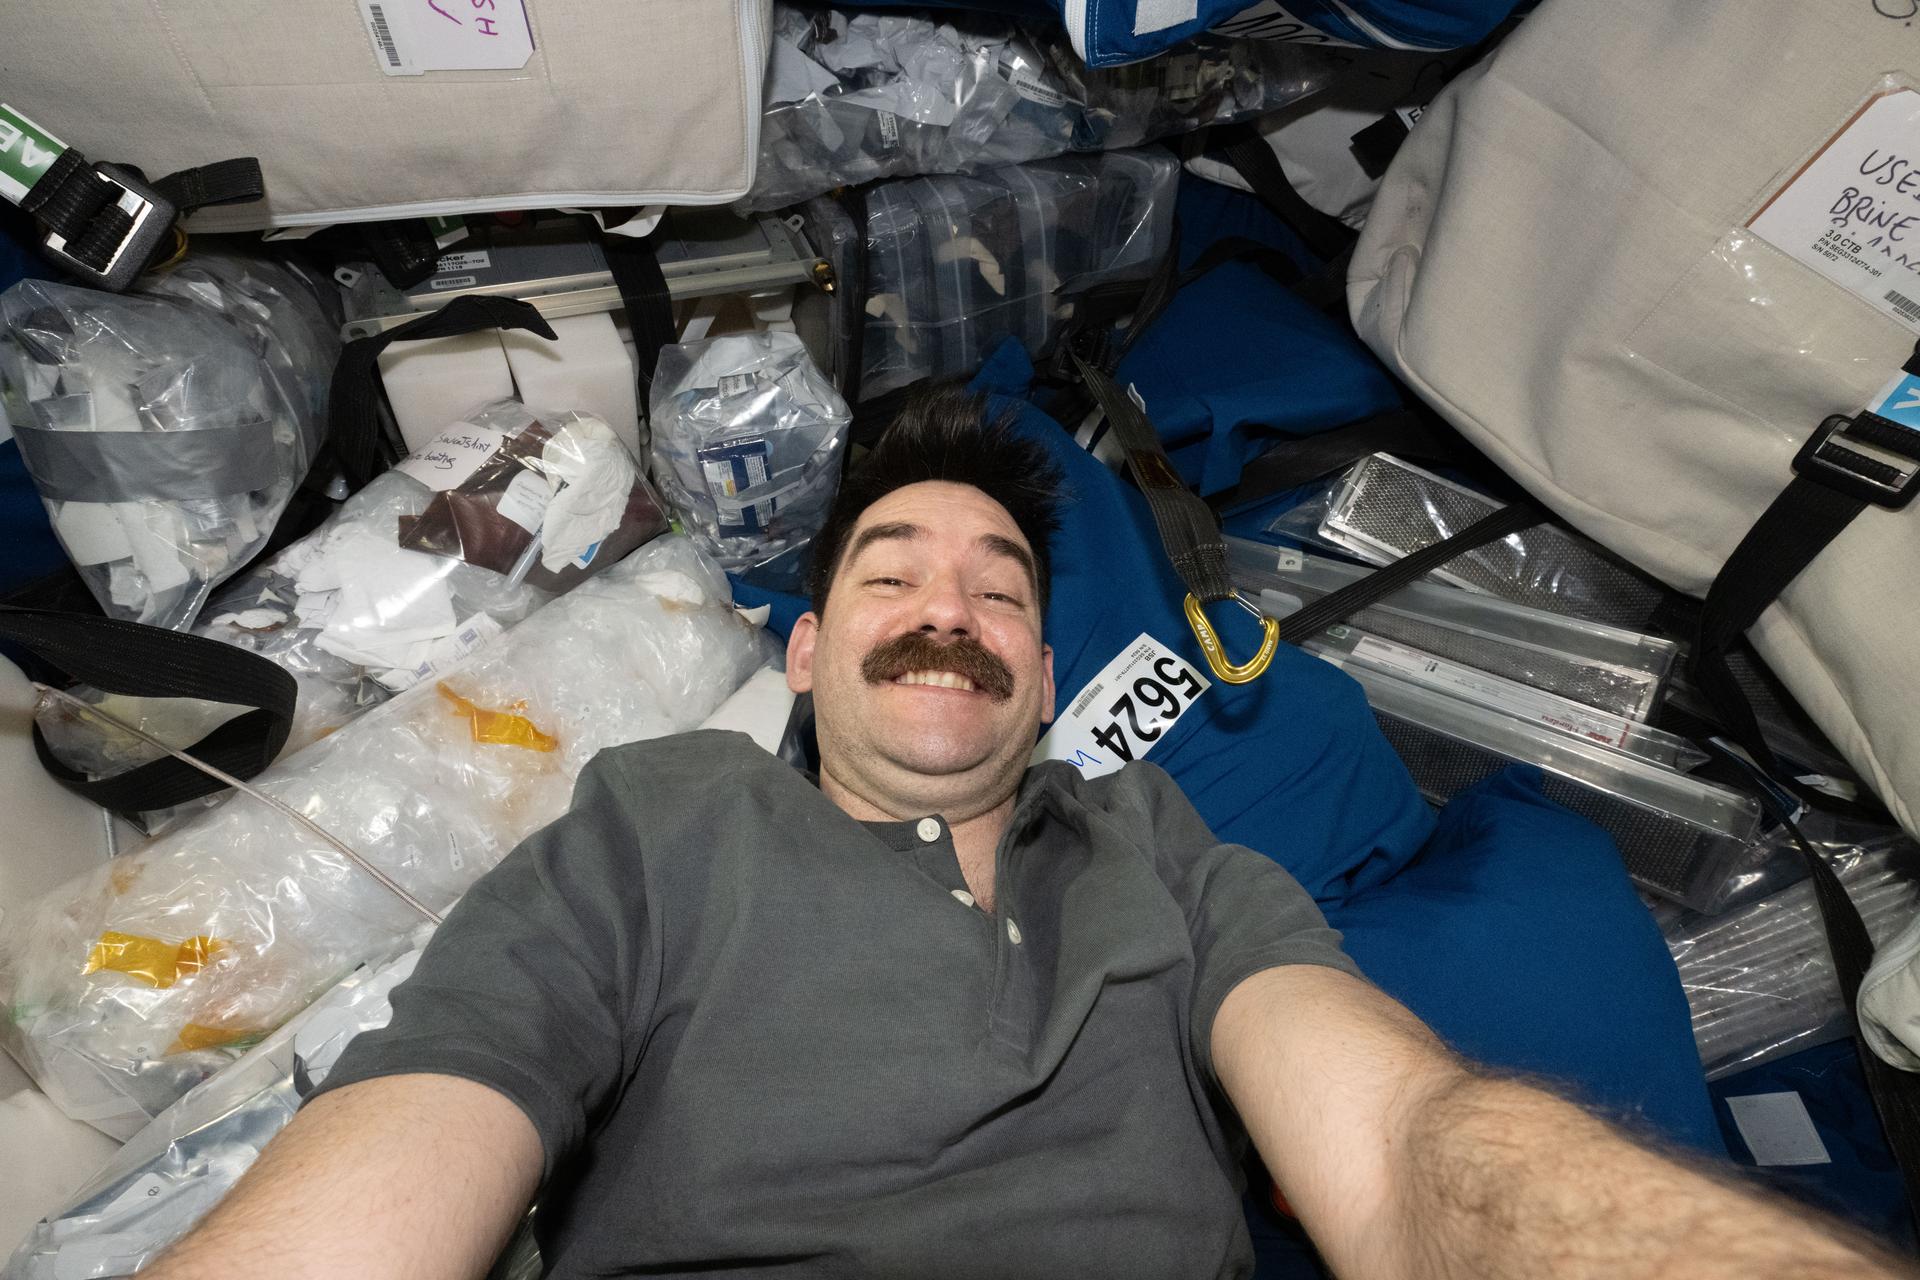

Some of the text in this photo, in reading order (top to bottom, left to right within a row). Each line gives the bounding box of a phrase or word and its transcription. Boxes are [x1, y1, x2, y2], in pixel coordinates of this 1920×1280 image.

[1825, 229, 1862, 254] 3.0 CTB
[1196, 624, 1215, 652] CAMP
[1091, 657, 1203, 763] 5624
